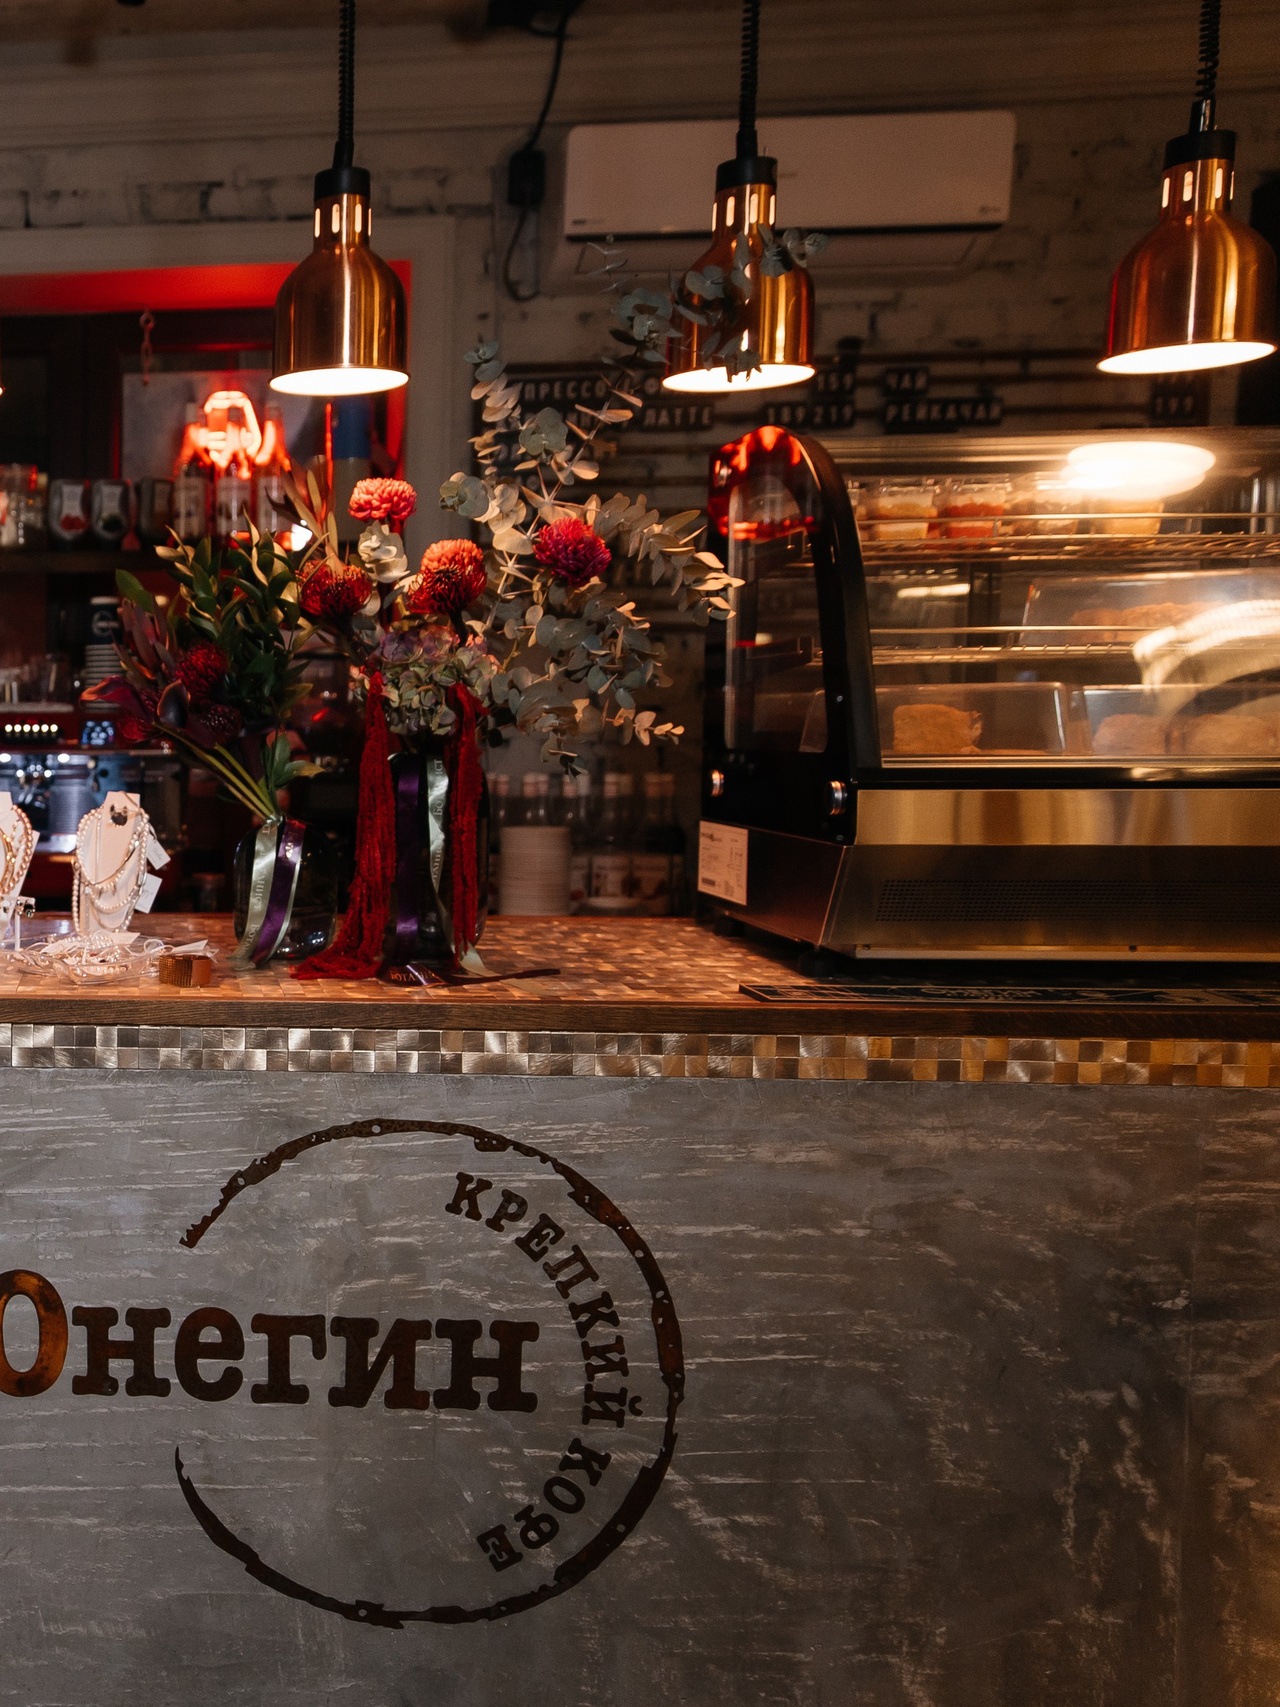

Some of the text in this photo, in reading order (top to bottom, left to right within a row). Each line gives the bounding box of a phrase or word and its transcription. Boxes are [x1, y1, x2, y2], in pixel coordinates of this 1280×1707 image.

[643, 406, 712, 428] ЛАТТЕ
[444, 1171, 642, 1573] КРЕПКИЙ КОФЕ
